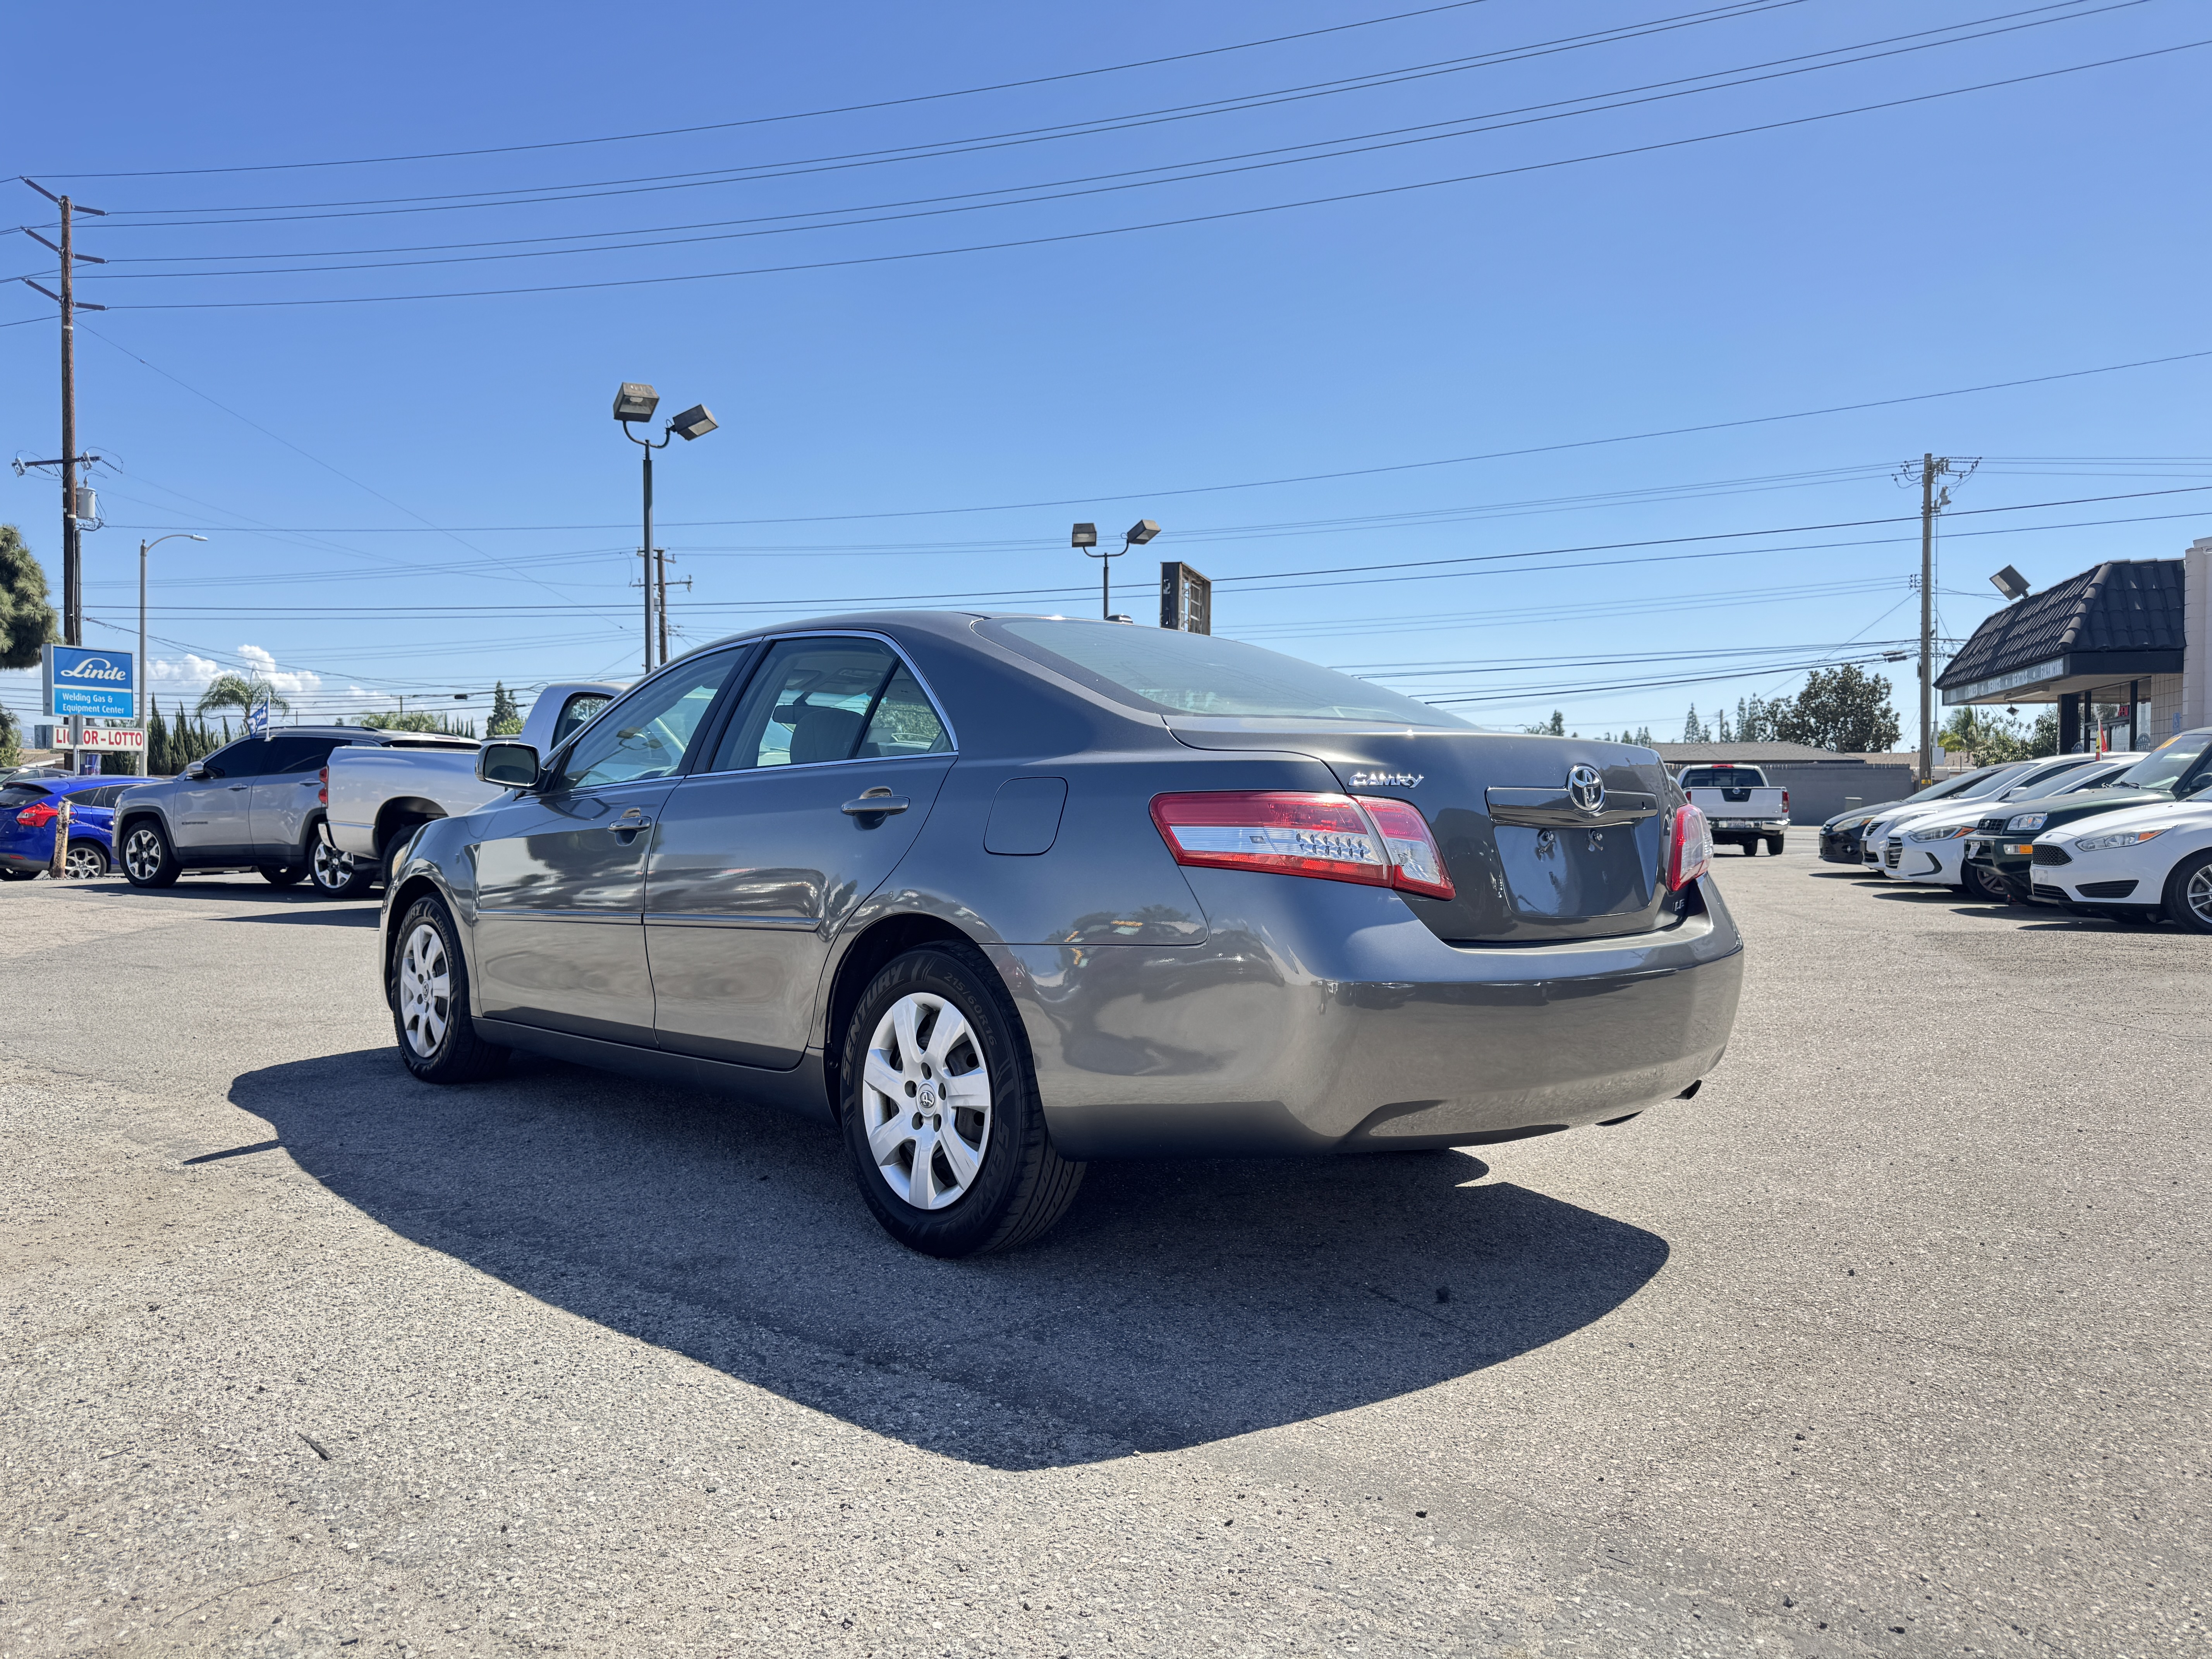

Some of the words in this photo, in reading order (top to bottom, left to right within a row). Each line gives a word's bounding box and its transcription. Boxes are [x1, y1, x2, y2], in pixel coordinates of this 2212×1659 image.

[60, 658, 126, 681] Linde
[62, 692, 91, 704] Welding
[63, 703, 100, 713] Equipment
[102, 706, 124, 714] Center
[56, 729, 98, 745] LIOR
[108, 731, 142, 746] LOTTO
[1348, 772, 1424, 788] CAMRY
[1674, 899, 1685, 912] LE
[435, 914, 455, 968] TOURING
[842, 961, 905, 1086] SENTURY
